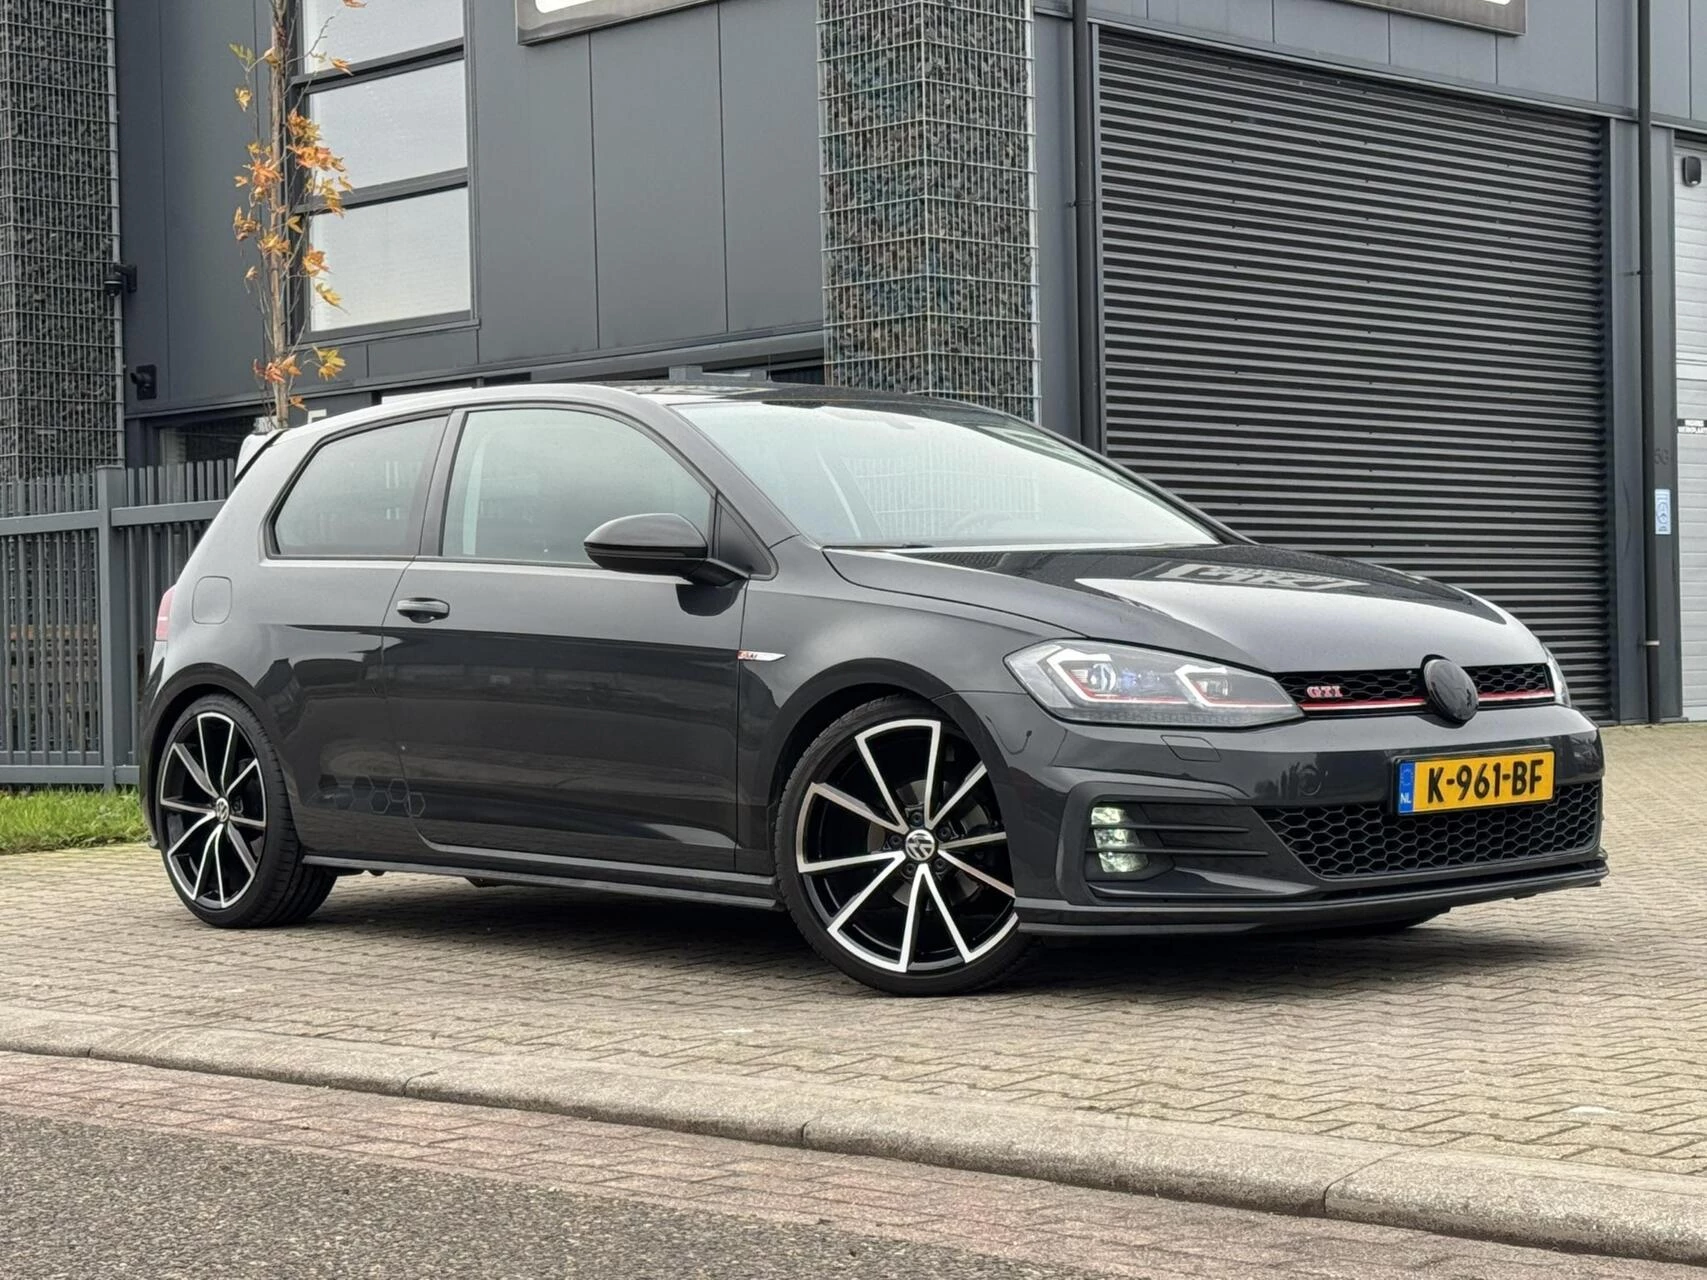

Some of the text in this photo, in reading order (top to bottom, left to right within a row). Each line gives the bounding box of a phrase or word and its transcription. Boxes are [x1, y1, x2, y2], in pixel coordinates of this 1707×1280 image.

[1306, 685, 1343, 698] GTI
[1427, 759, 1544, 804] K-961-BF
[1400, 792, 1411, 804] NL
